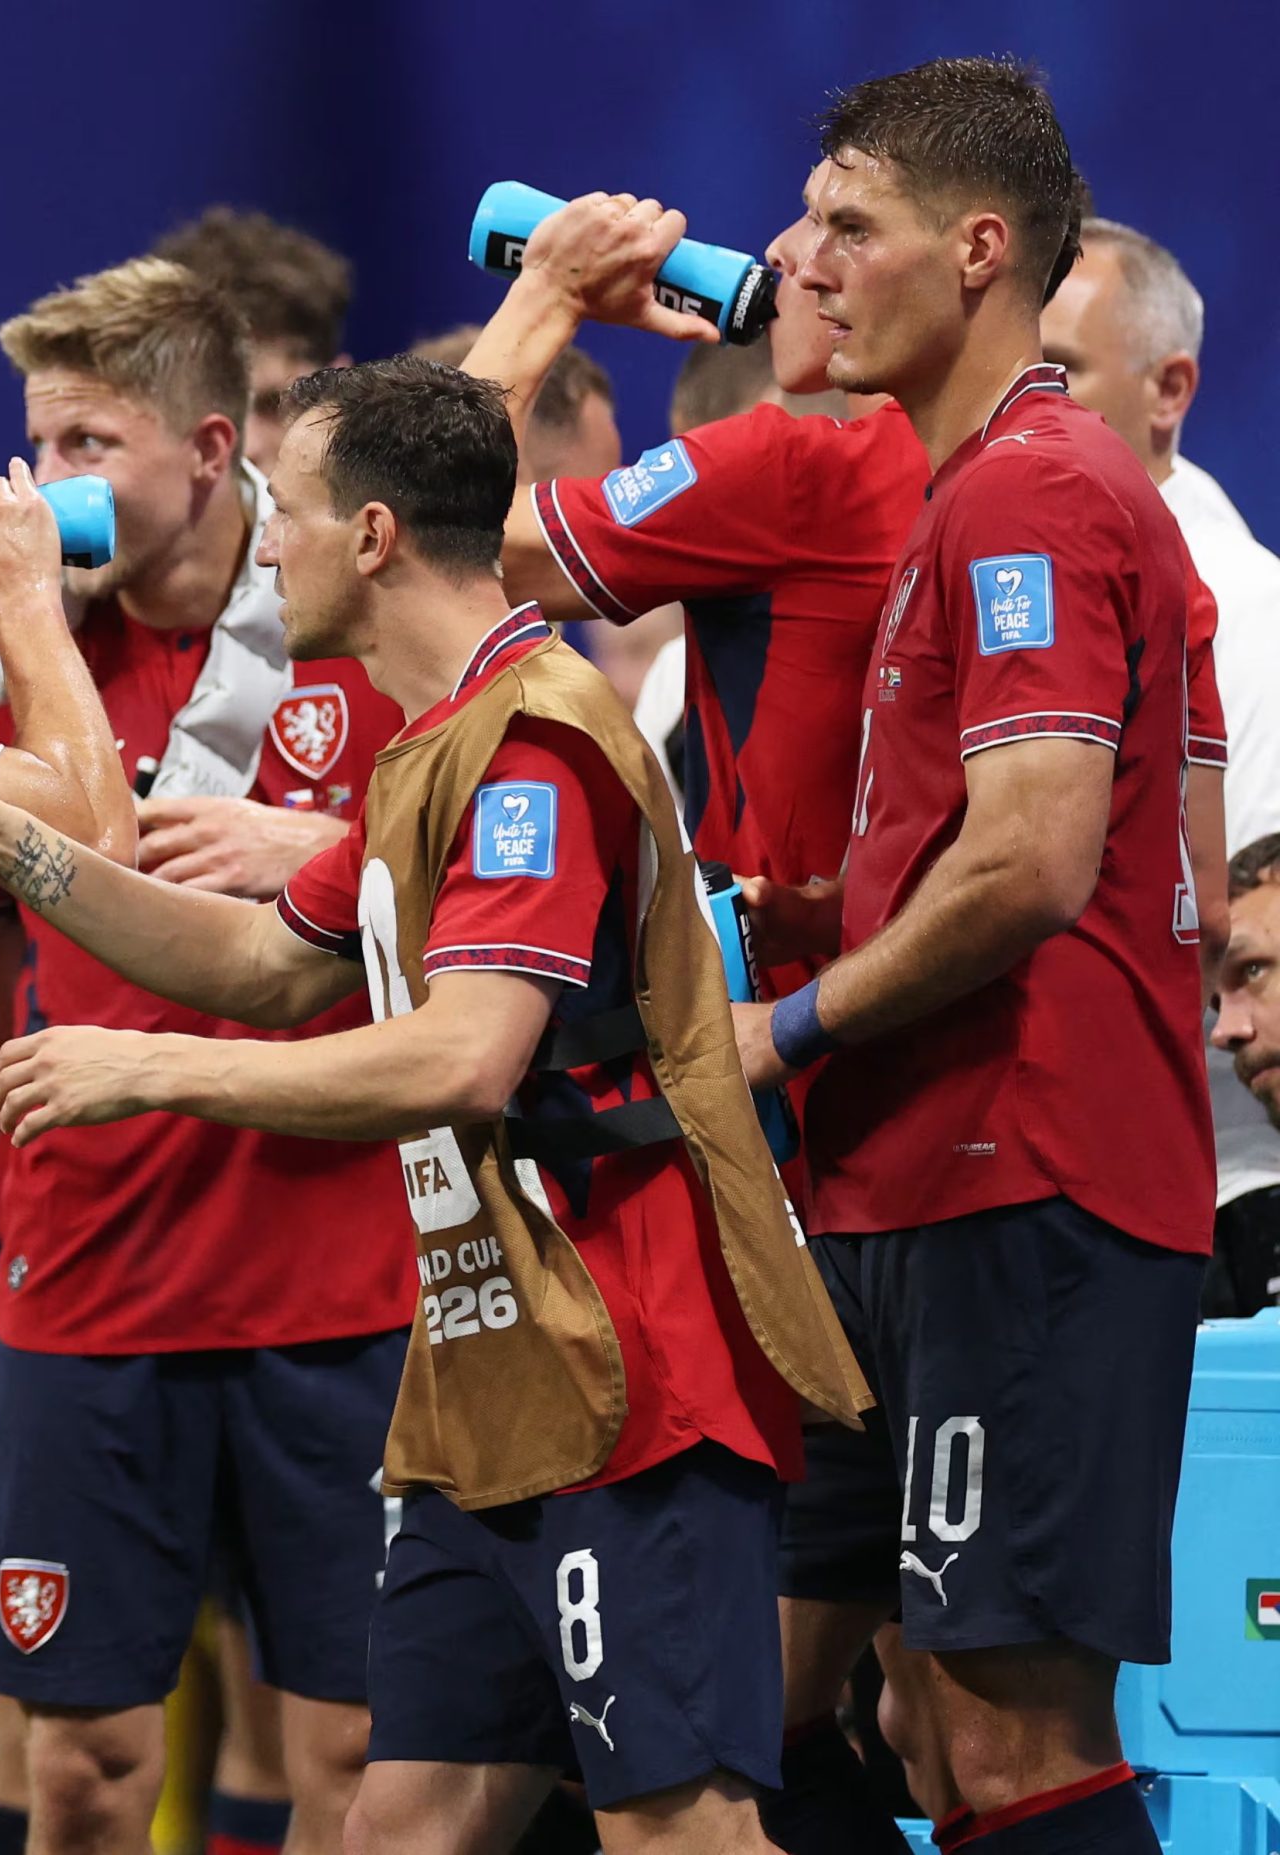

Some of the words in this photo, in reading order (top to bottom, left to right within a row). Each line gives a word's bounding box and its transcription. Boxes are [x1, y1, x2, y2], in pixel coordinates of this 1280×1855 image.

[733, 269, 762, 330] POWERADE
[994, 612, 1030, 632] PEACE
[1015, 594, 1032, 612] For
[1001, 630, 1022, 642] FIFA
[496, 839, 535, 856] PEACE
[404, 1157, 453, 1199] IFA
[424, 1276, 519, 1344] 226
[901, 1416, 985, 1542] 10
[556, 1548, 604, 1682] 8
